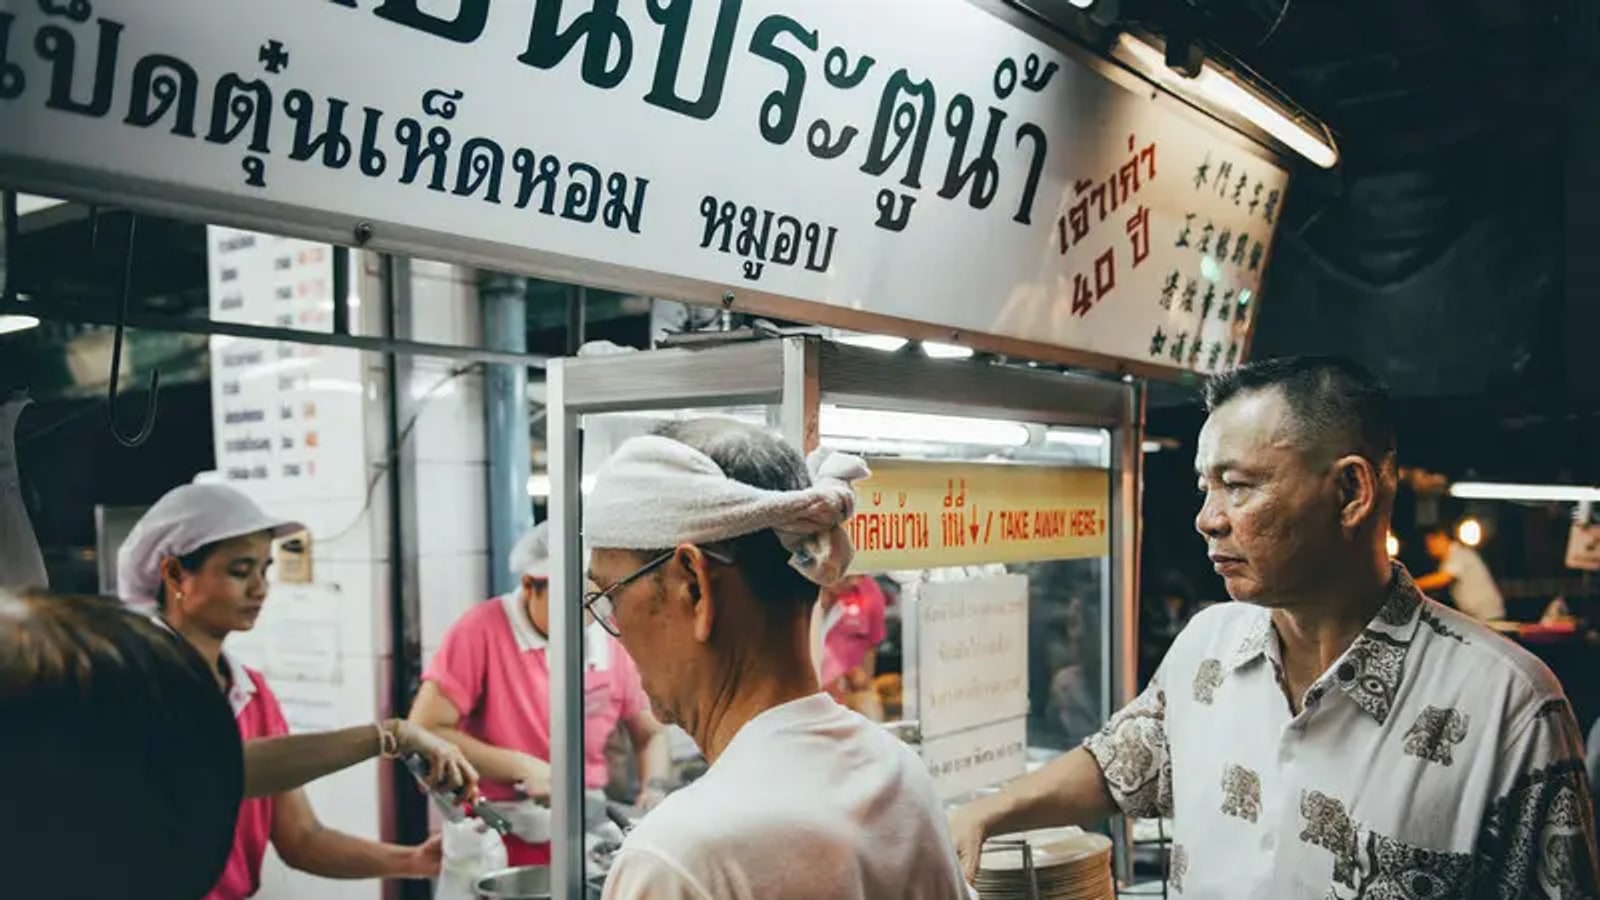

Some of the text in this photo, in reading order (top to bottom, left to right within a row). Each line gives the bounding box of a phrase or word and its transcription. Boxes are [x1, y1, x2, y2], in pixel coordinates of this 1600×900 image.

[699, 195, 839, 281] หมูอบ
[1057, 133, 1156, 254] เจ้าเก่า
[1070, 246, 1116, 318] 40
[1125, 204, 1151, 270] ปี
[1000, 510, 1029, 541] TAKE
[1033, 509, 1066, 539] AWAY
[1069, 507, 1097, 537] HERE
